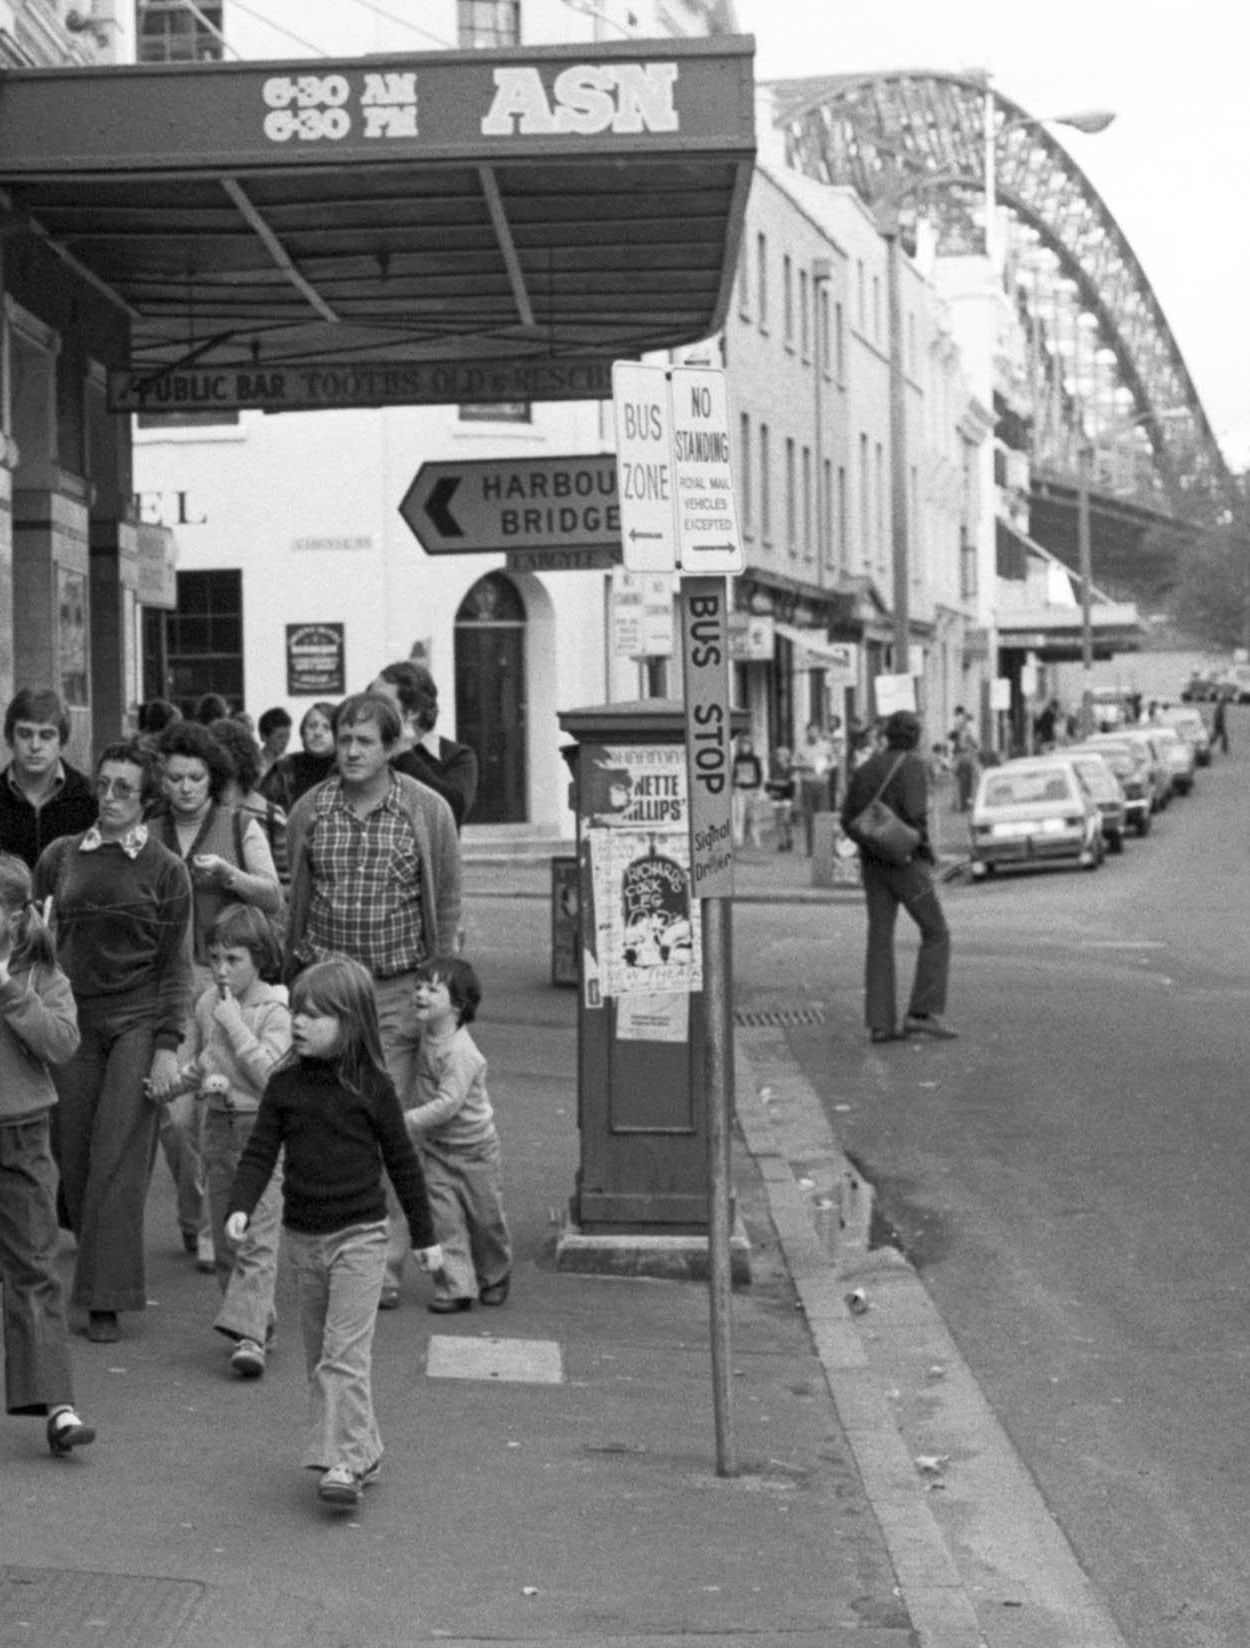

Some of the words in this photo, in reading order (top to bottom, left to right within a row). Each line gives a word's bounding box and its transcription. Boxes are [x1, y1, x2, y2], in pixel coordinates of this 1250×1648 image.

[481, 62, 680, 135] ASN
[363, 105, 418, 138] PM
[236, 373, 285, 400] BAR
[691, 386, 711, 418] NO
[624, 403, 662, 441] BUS
[675, 430, 729, 463] STANDING
[622, 463, 669, 500] ZONE
[710, 477, 731, 490] MAIL
[501, 504, 622, 536] BRIDGE
[685, 498, 727, 511] VEHICLES
[684, 518, 732, 531] EXCEPTED
[690, 596, 721, 667] BUS
[694, 704, 725, 795] STOP
[628, 894, 664, 910] LEG
